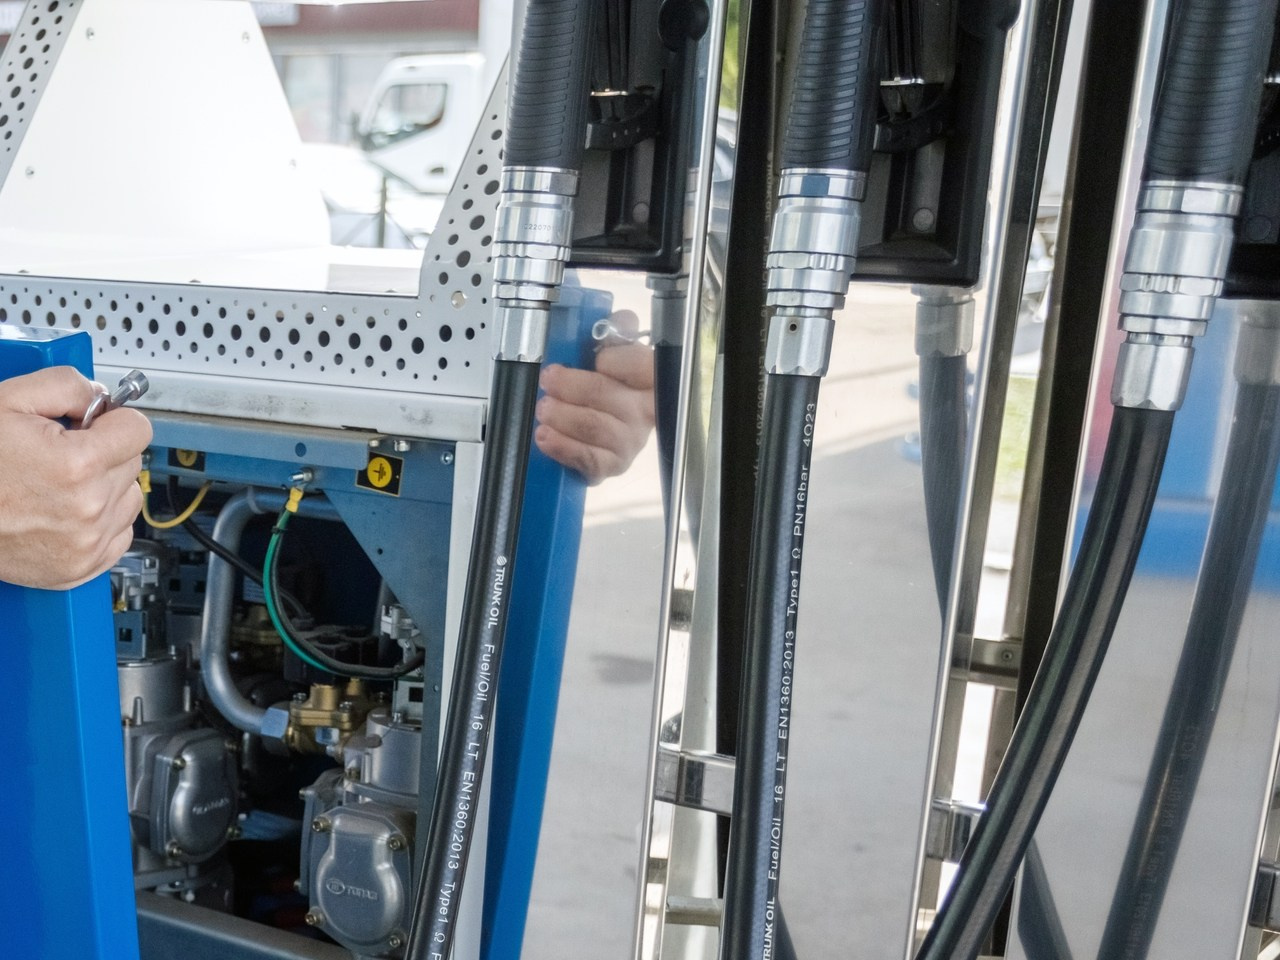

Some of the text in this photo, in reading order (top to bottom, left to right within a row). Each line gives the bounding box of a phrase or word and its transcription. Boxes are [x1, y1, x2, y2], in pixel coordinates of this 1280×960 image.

[803, 403, 816, 447] 4Q23
[793, 465, 809, 536] PN16bar
[491, 567, 506, 606] TRUNK
[787, 570, 800, 617] Type1
[487, 607, 500, 629] OIL
[476, 643, 495, 701] Fuel/Oil
[778, 630, 795, 739] EN1360:2013
[471, 714, 484, 731] 16
[467, 742, 480, 760] LT
[776, 752, 786, 772] LT
[774, 785, 784, 803] 16
[448, 771, 475, 870] EN1360:2013
[768, 817, 781, 881] Fuel/Oil
[437, 882, 456, 924] Type1
[766, 896, 775, 921] OIL
